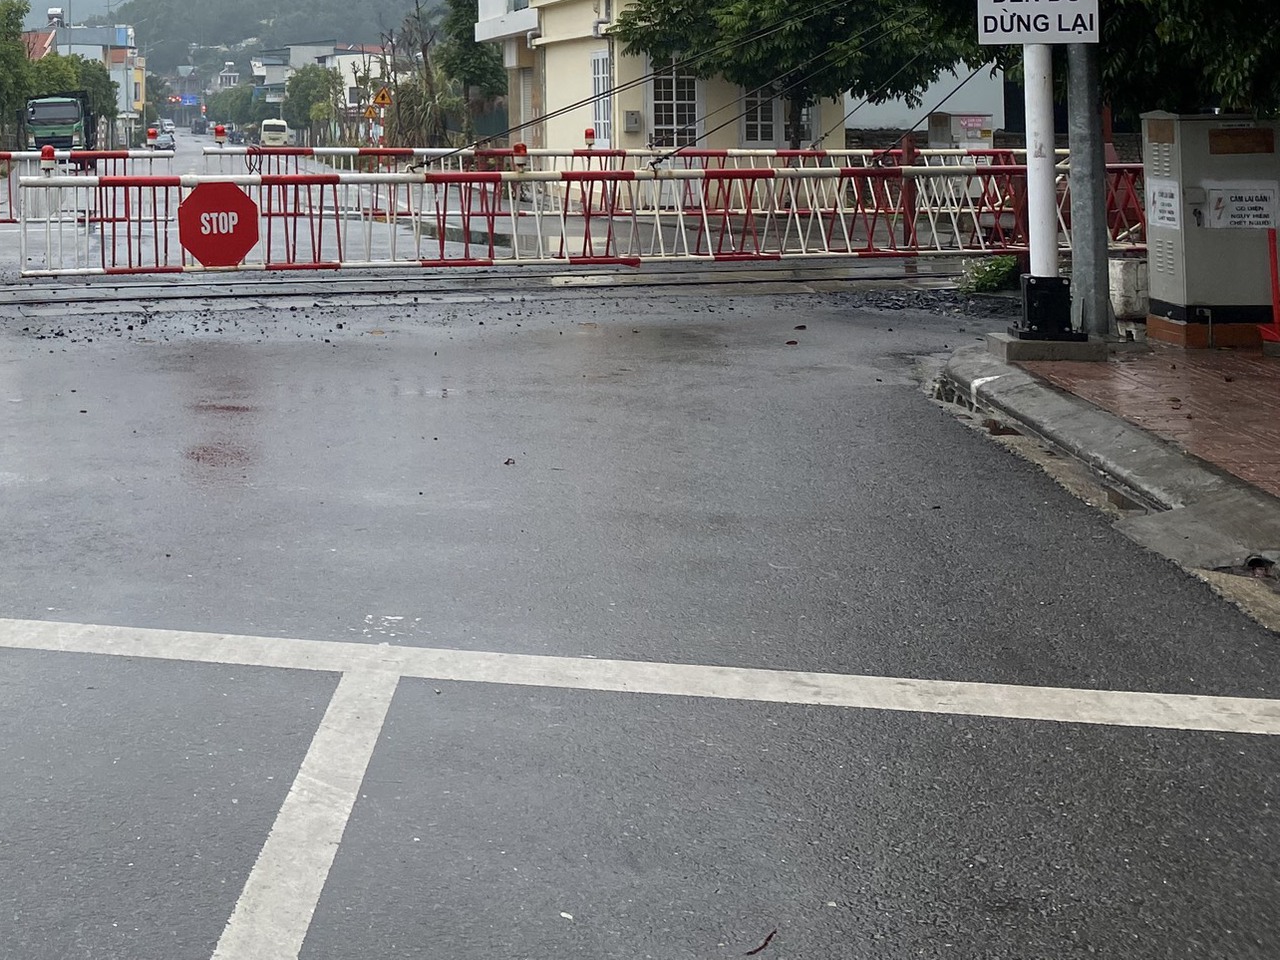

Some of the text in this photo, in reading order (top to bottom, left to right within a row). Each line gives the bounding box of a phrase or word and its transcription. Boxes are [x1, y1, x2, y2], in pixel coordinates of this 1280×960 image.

[983, 8, 1094, 35] DỪNG LẠI
[200, 211, 239, 235] STOP
